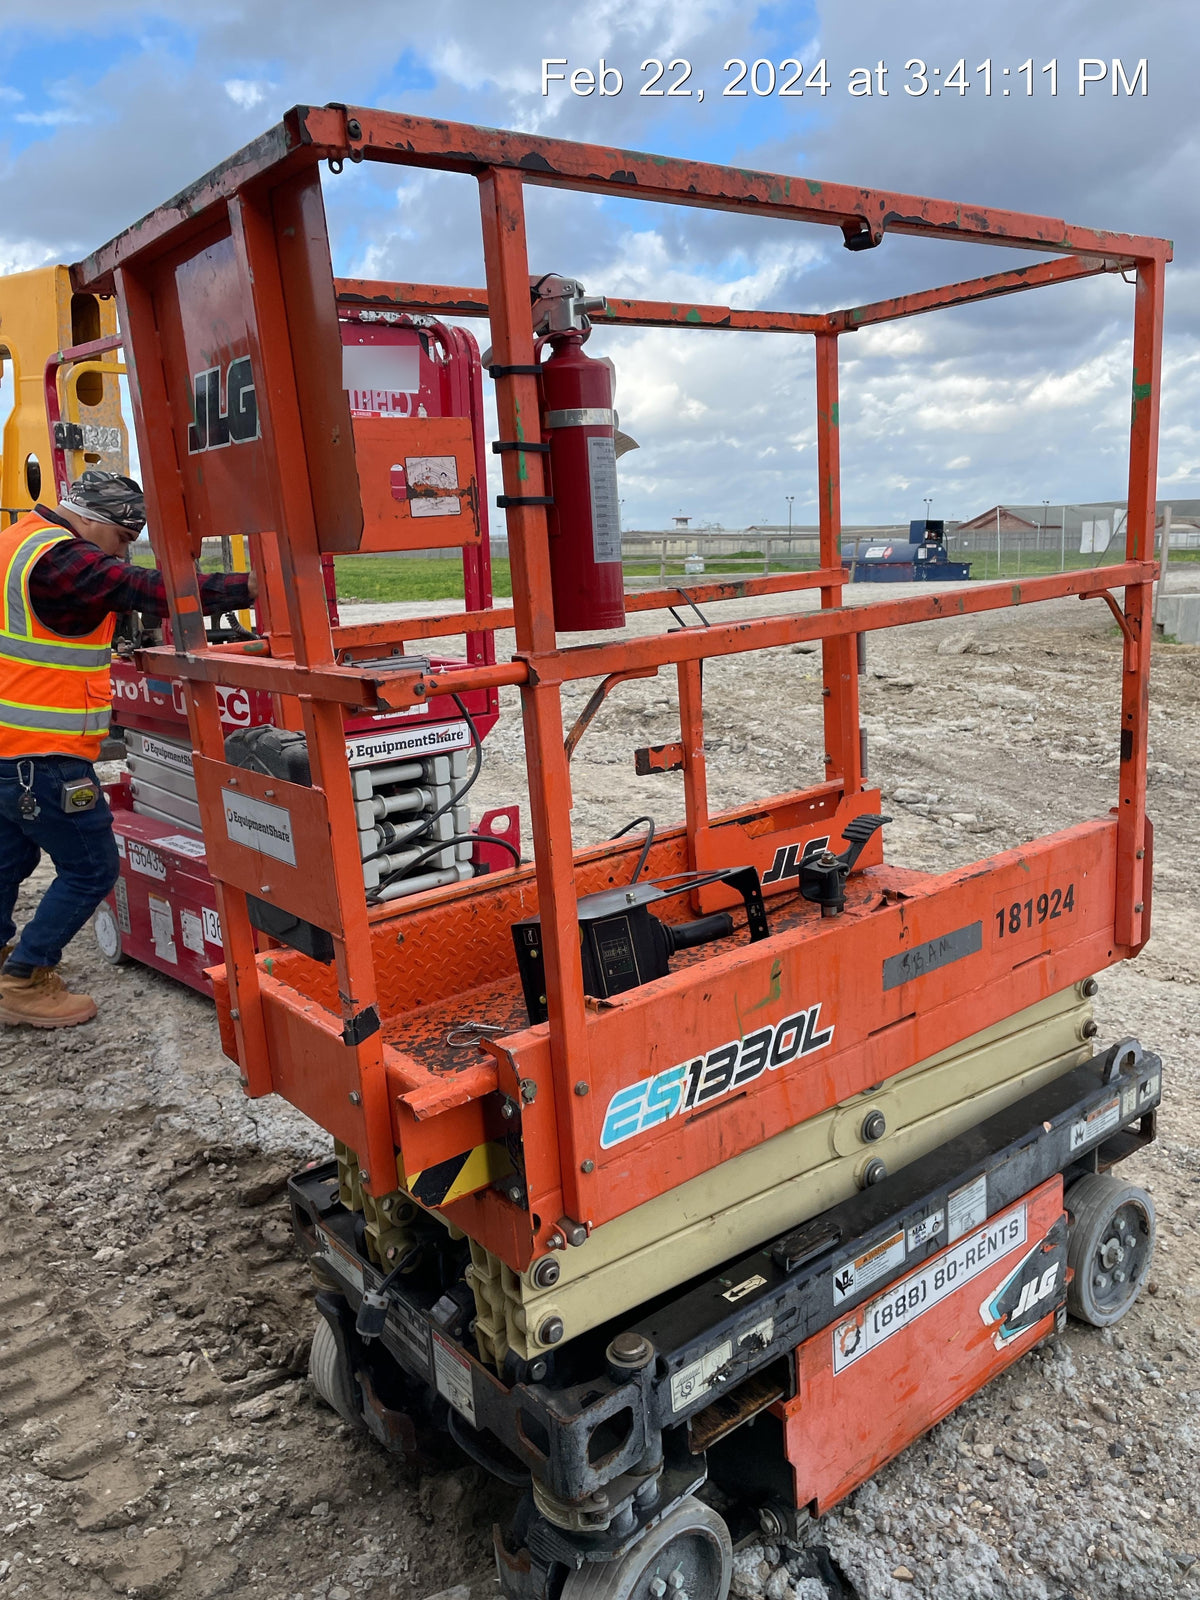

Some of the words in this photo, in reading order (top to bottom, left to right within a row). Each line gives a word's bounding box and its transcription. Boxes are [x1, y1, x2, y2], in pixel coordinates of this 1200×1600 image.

[187, 354, 260, 455] JLG
[356, 730, 464, 758] EquipmentShare
[233, 810, 290, 842] EquipmentShare
[995, 884, 1075, 938] 181924
[600, 1002, 835, 1150] ES1330L
[873, 1279, 927, 1335] (888)
[933, 1218, 1019, 1291] 80-RENTS
[1011, 1261, 1060, 1321] JLG
